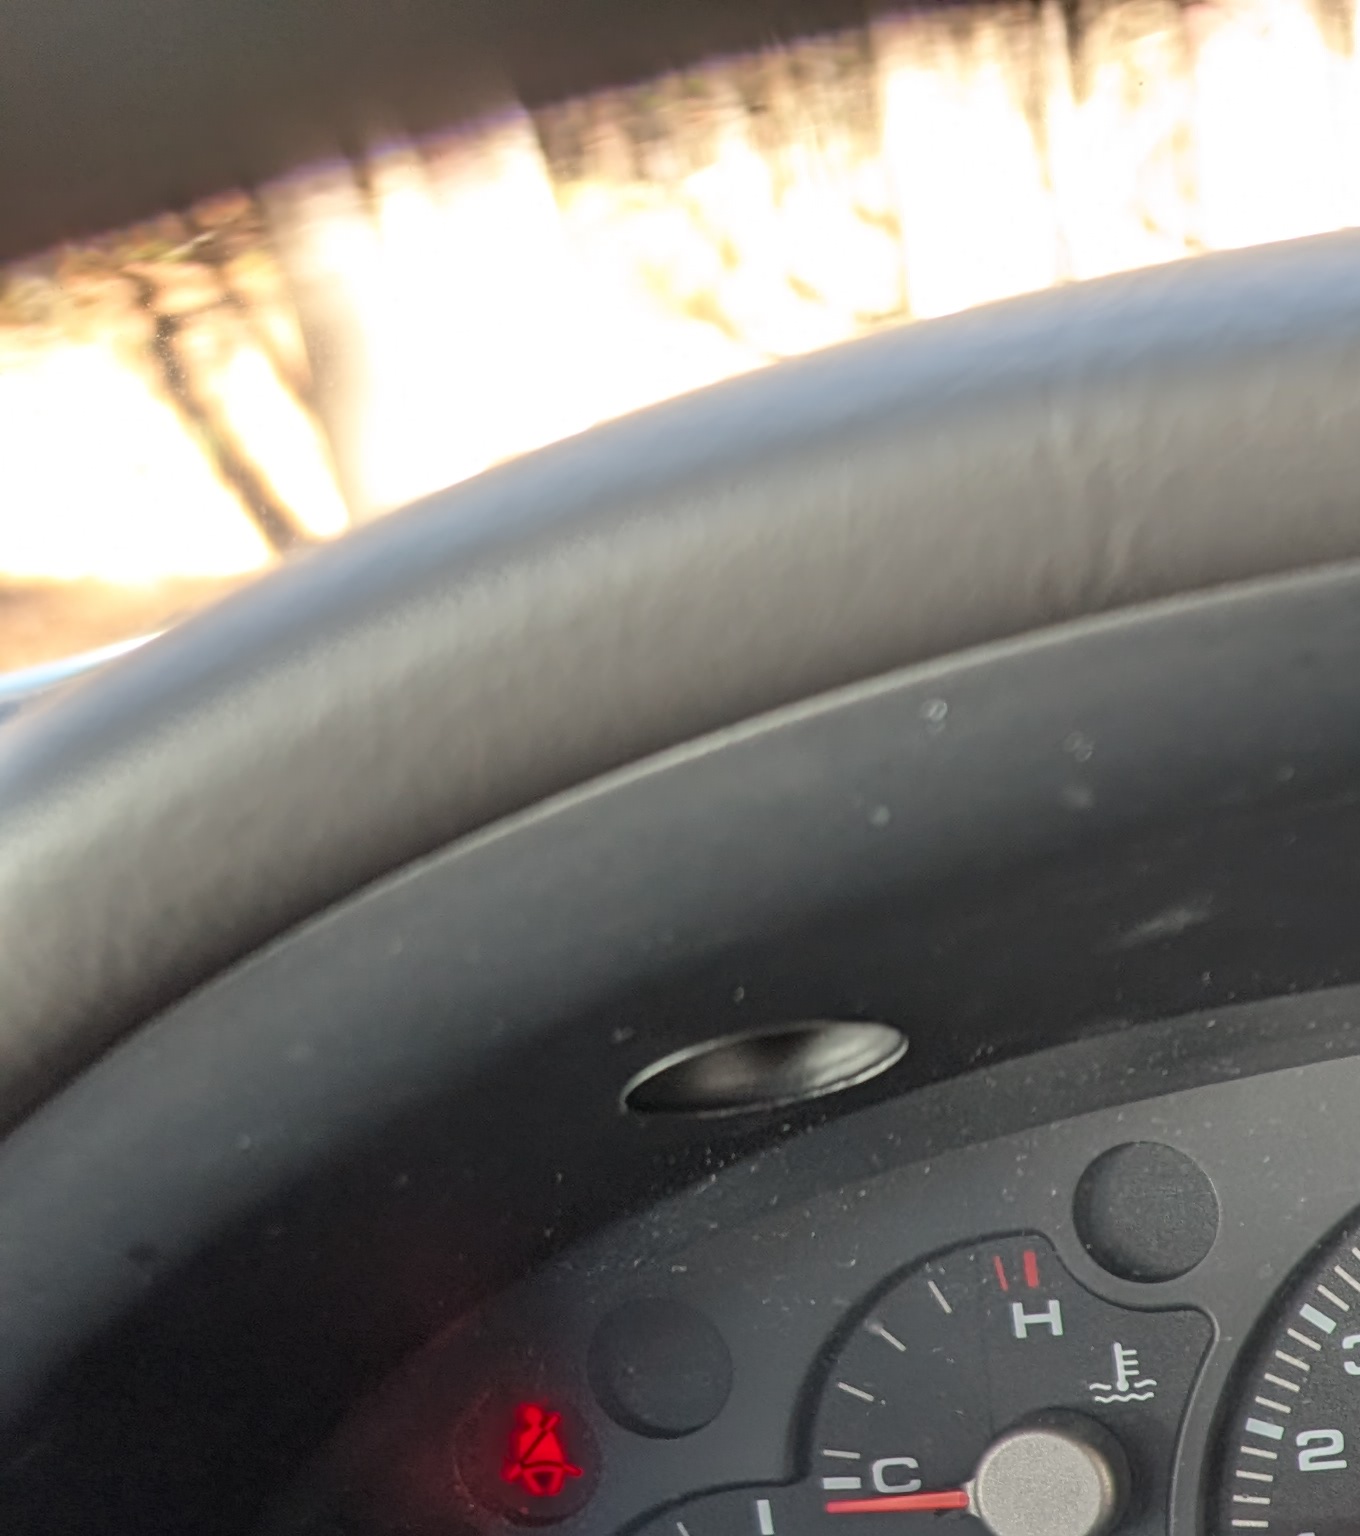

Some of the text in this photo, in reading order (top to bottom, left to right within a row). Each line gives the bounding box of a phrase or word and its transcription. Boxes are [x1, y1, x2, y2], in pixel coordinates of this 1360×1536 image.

[1011, 1299, 1063, 1339] H
[1295, 1428, 1347, 1472] 2
[871, 1456, 922, 1495] C
